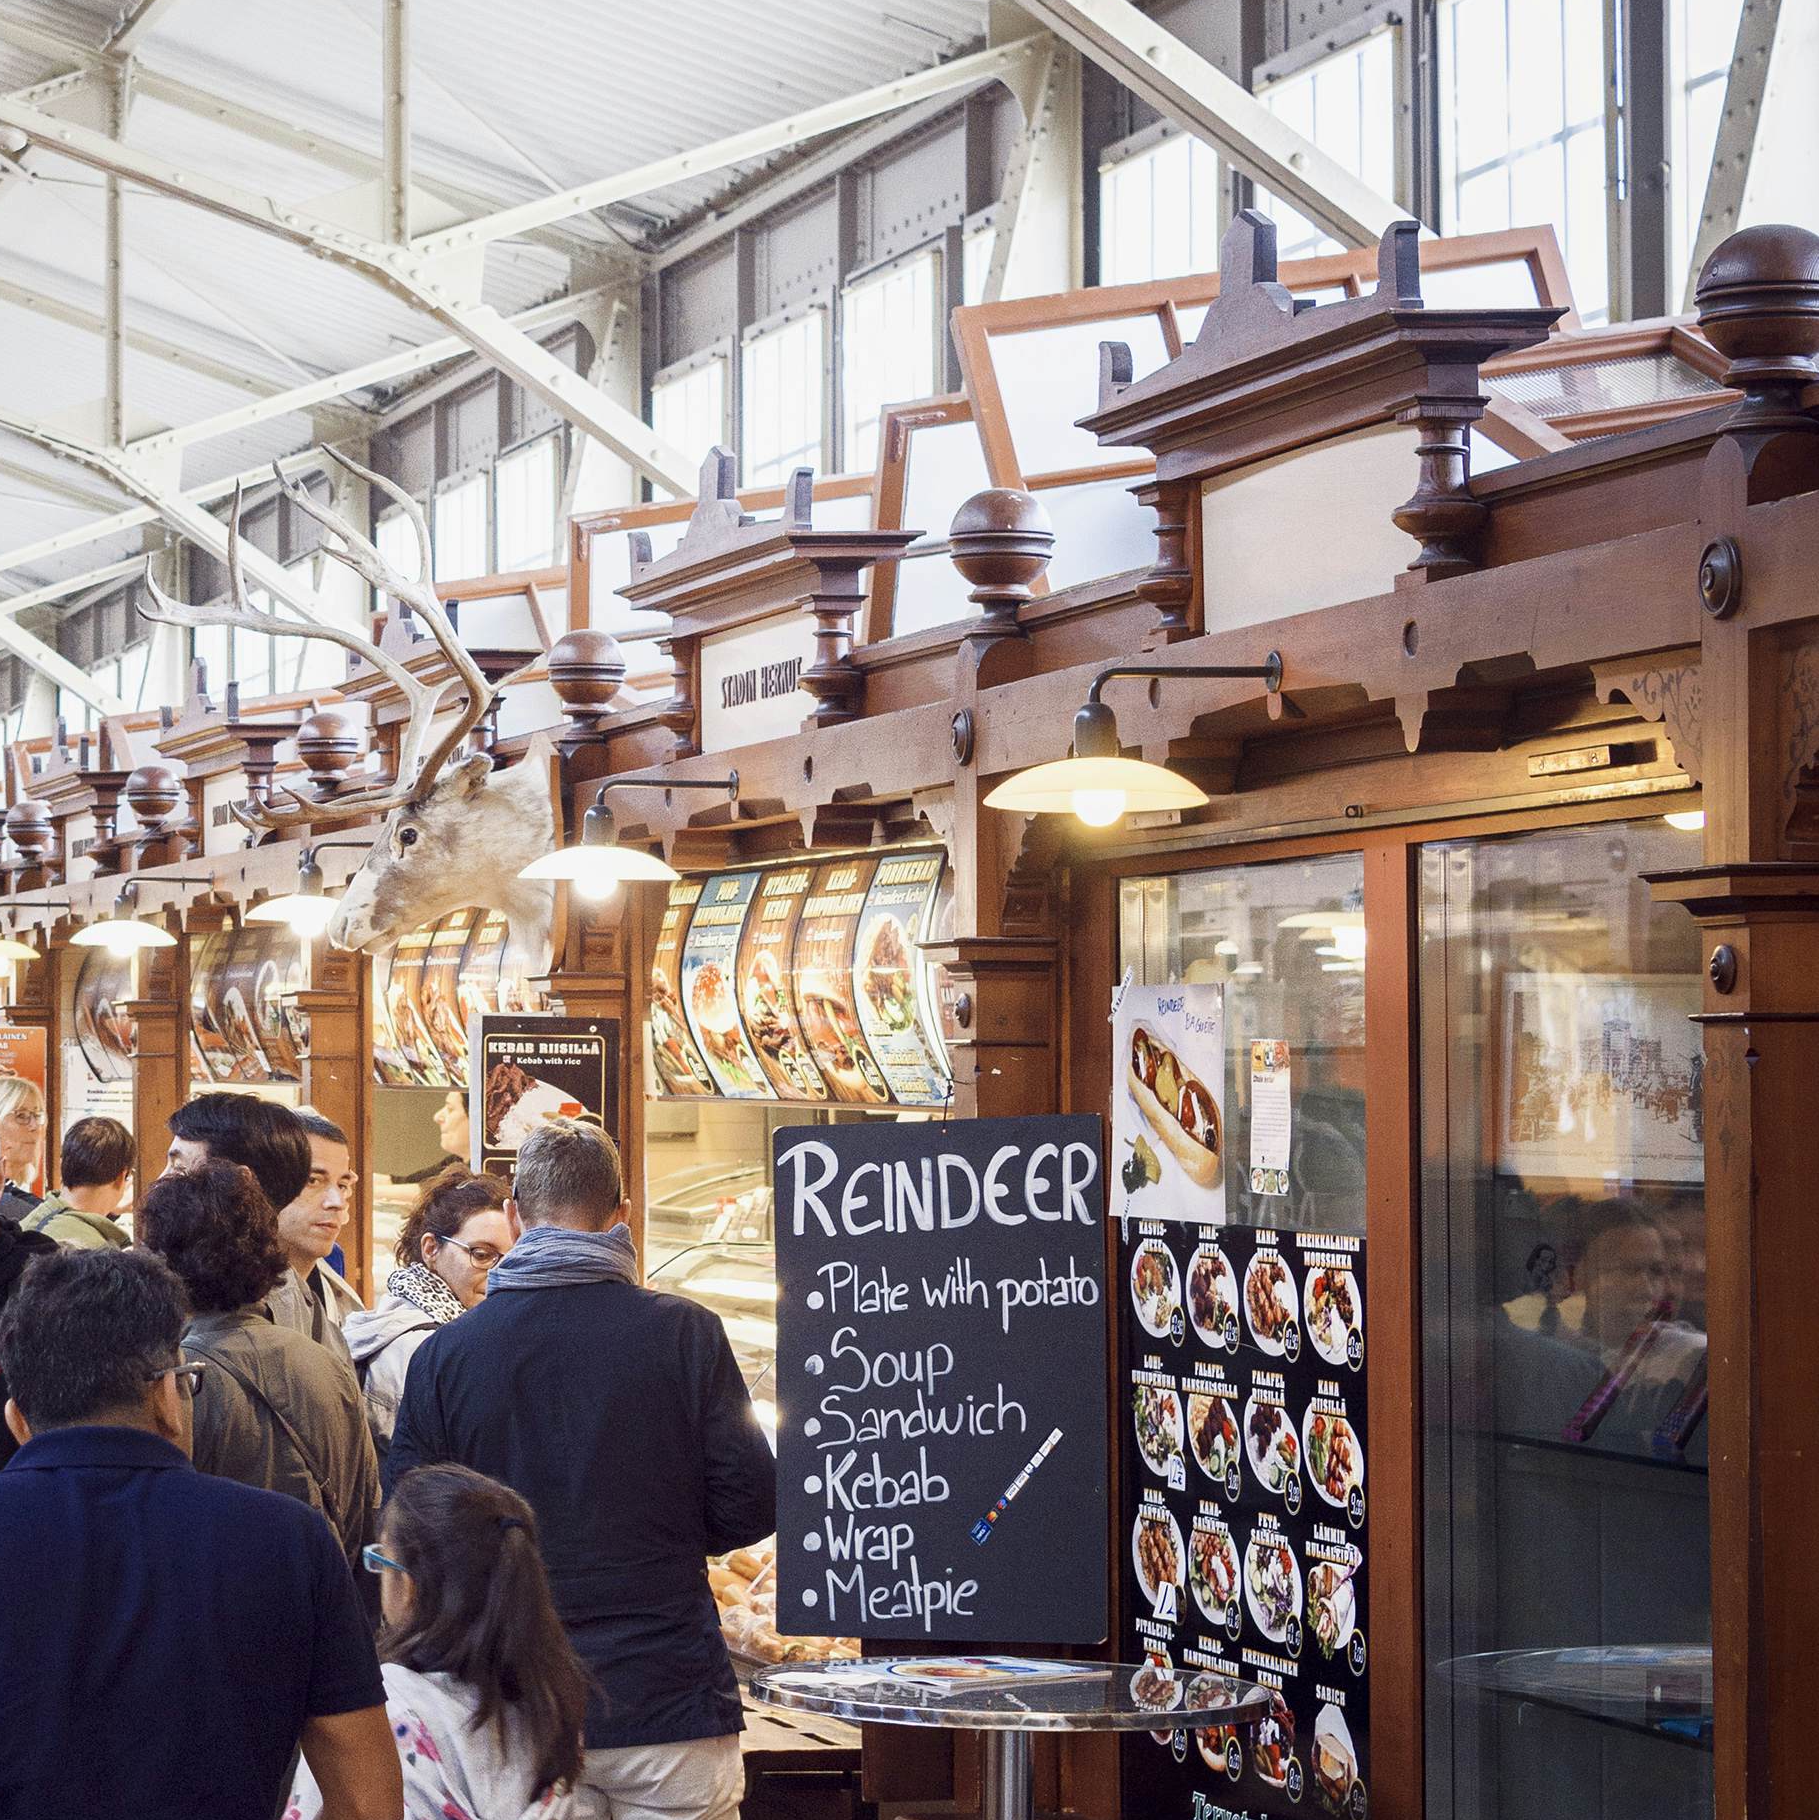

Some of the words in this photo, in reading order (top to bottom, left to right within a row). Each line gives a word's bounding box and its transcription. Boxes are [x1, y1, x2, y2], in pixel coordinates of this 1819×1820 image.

[761, 656, 803, 699] HERKUT
[488, 1041, 535, 1054] KEBAB
[538, 1040, 601, 1056] RIISILLÄ
[516, 1056, 543, 1066] Kebab
[544, 1057, 562, 1066] with
[776, 1140, 1098, 1237] REINDEER
[1139, 1220, 1167, 1237] KASVIS-
[1198, 1225, 1219, 1241] LIHA-
[1255, 1229, 1279, 1245] KANA-
[1198, 1242, 1220, 1258] MEZE
[1295, 1232, 1360, 1253] KREIKKALAINEN
[1257, 1247, 1279, 1265] MEZE
[1303, 1251, 1353, 1270] MOUSSAKKA
[816, 1260, 909, 1314] Plate
[921, 1256, 989, 1309] with
[995, 1255, 1099, 1334] potato
[828, 1326, 954, 1396] Soup
[1194, 1361, 1225, 1380] FALAFEL
[1251, 1369, 1285, 1389] FALAFEL
[1318, 1379, 1340, 1397] KANA
[1251, 1387, 1286, 1407] RIISILLÄ
[1311, 1395, 1347, 1417] RIISILLÄ
[816, 1382, 1027, 1449] Sandwich
[825, 1445, 950, 1512] Kebab
[1143, 1487, 1166, 1504] KANA-
[1199, 1499, 1222, 1517] KANA-
[1257, 1512, 1281, 1529] FETA-
[824, 1513, 915, 1570] Wrap
[1313, 1522, 1346, 1545] LÄMMIN
[825, 1555, 979, 1632] Meatpie
[1143, 1636, 1167, 1657] KEBAB
[1198, 1634, 1224, 1654] KEBAB-
[1257, 1669, 1283, 1691] KEBAB
[1315, 1684, 1346, 1707] SABICH
